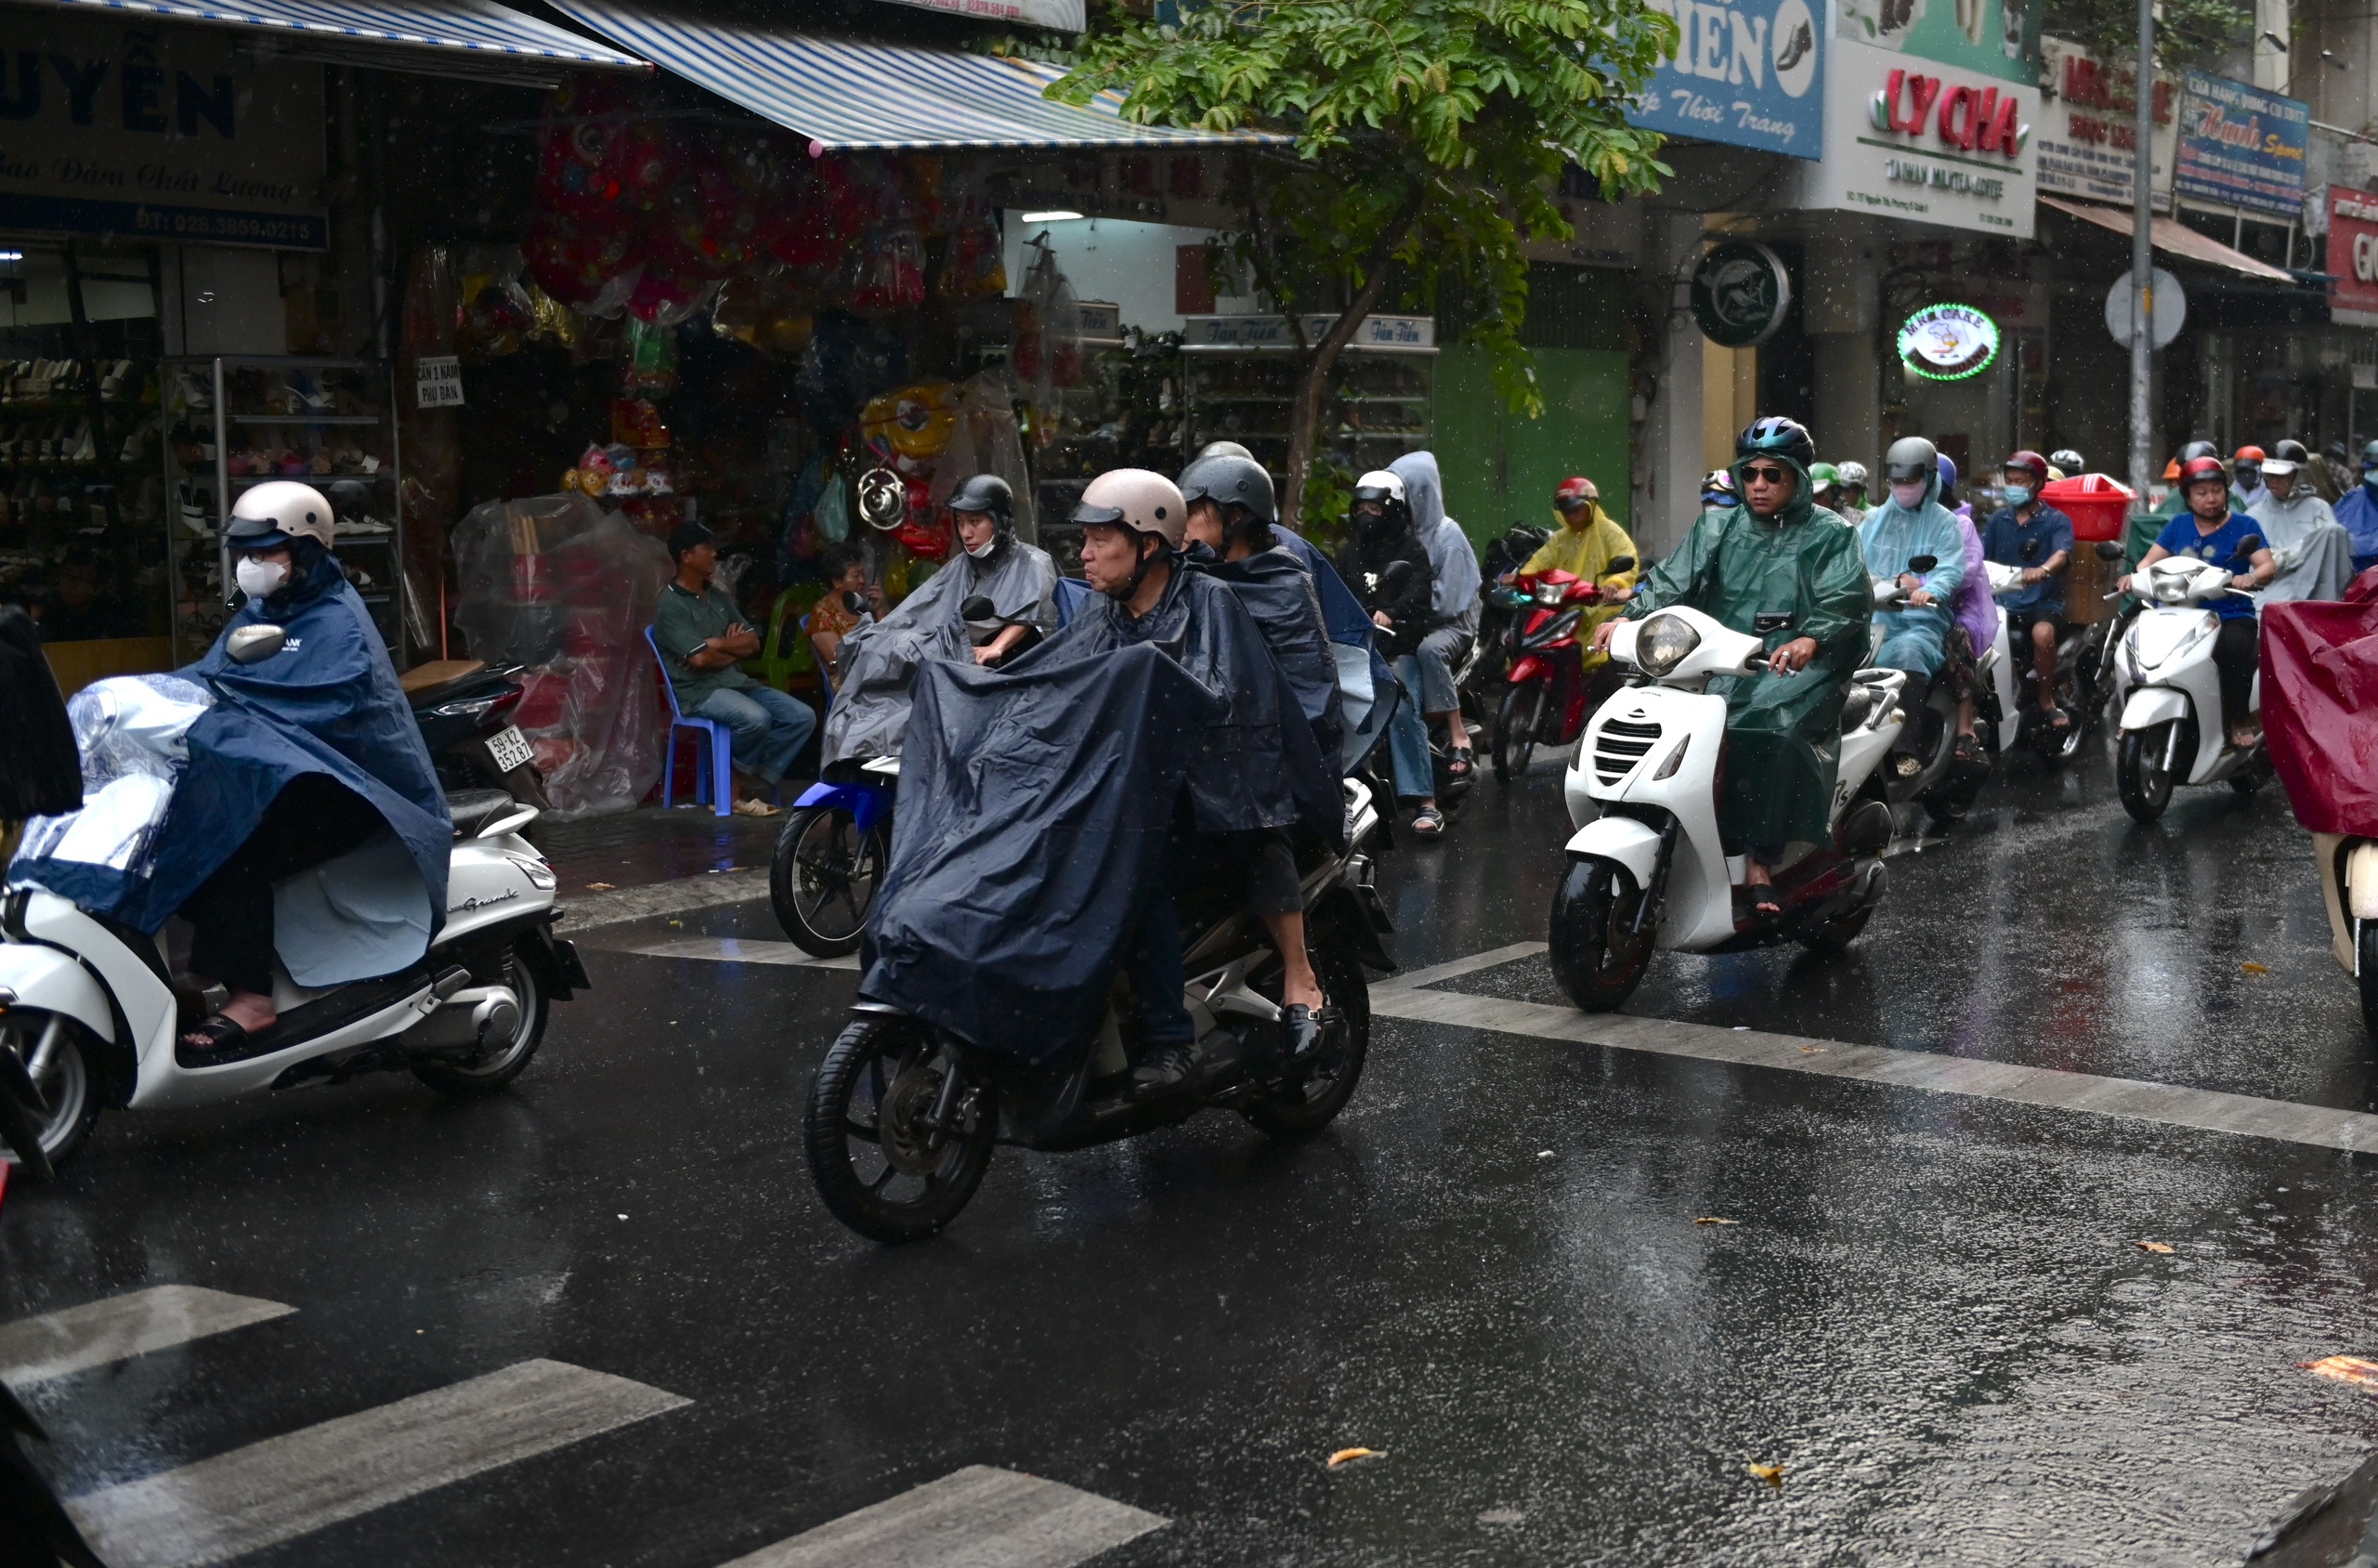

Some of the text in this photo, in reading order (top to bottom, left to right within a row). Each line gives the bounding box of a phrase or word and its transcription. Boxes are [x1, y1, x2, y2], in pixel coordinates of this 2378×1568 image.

[1670, 89, 1725, 124] Thời
[1731, 101, 1796, 144] Trang
[1887, 69, 1940, 136] LY
[1939, 85, 2019, 157] CHA
[1940, 308, 1985, 329] CAKE
[433, 365, 438, 380] 1
[439, 363, 459, 380] NAM
[439, 382, 459, 400] BÁN
[490, 729, 521, 753] 59-K2
[498, 742, 530, 770] 352.87
